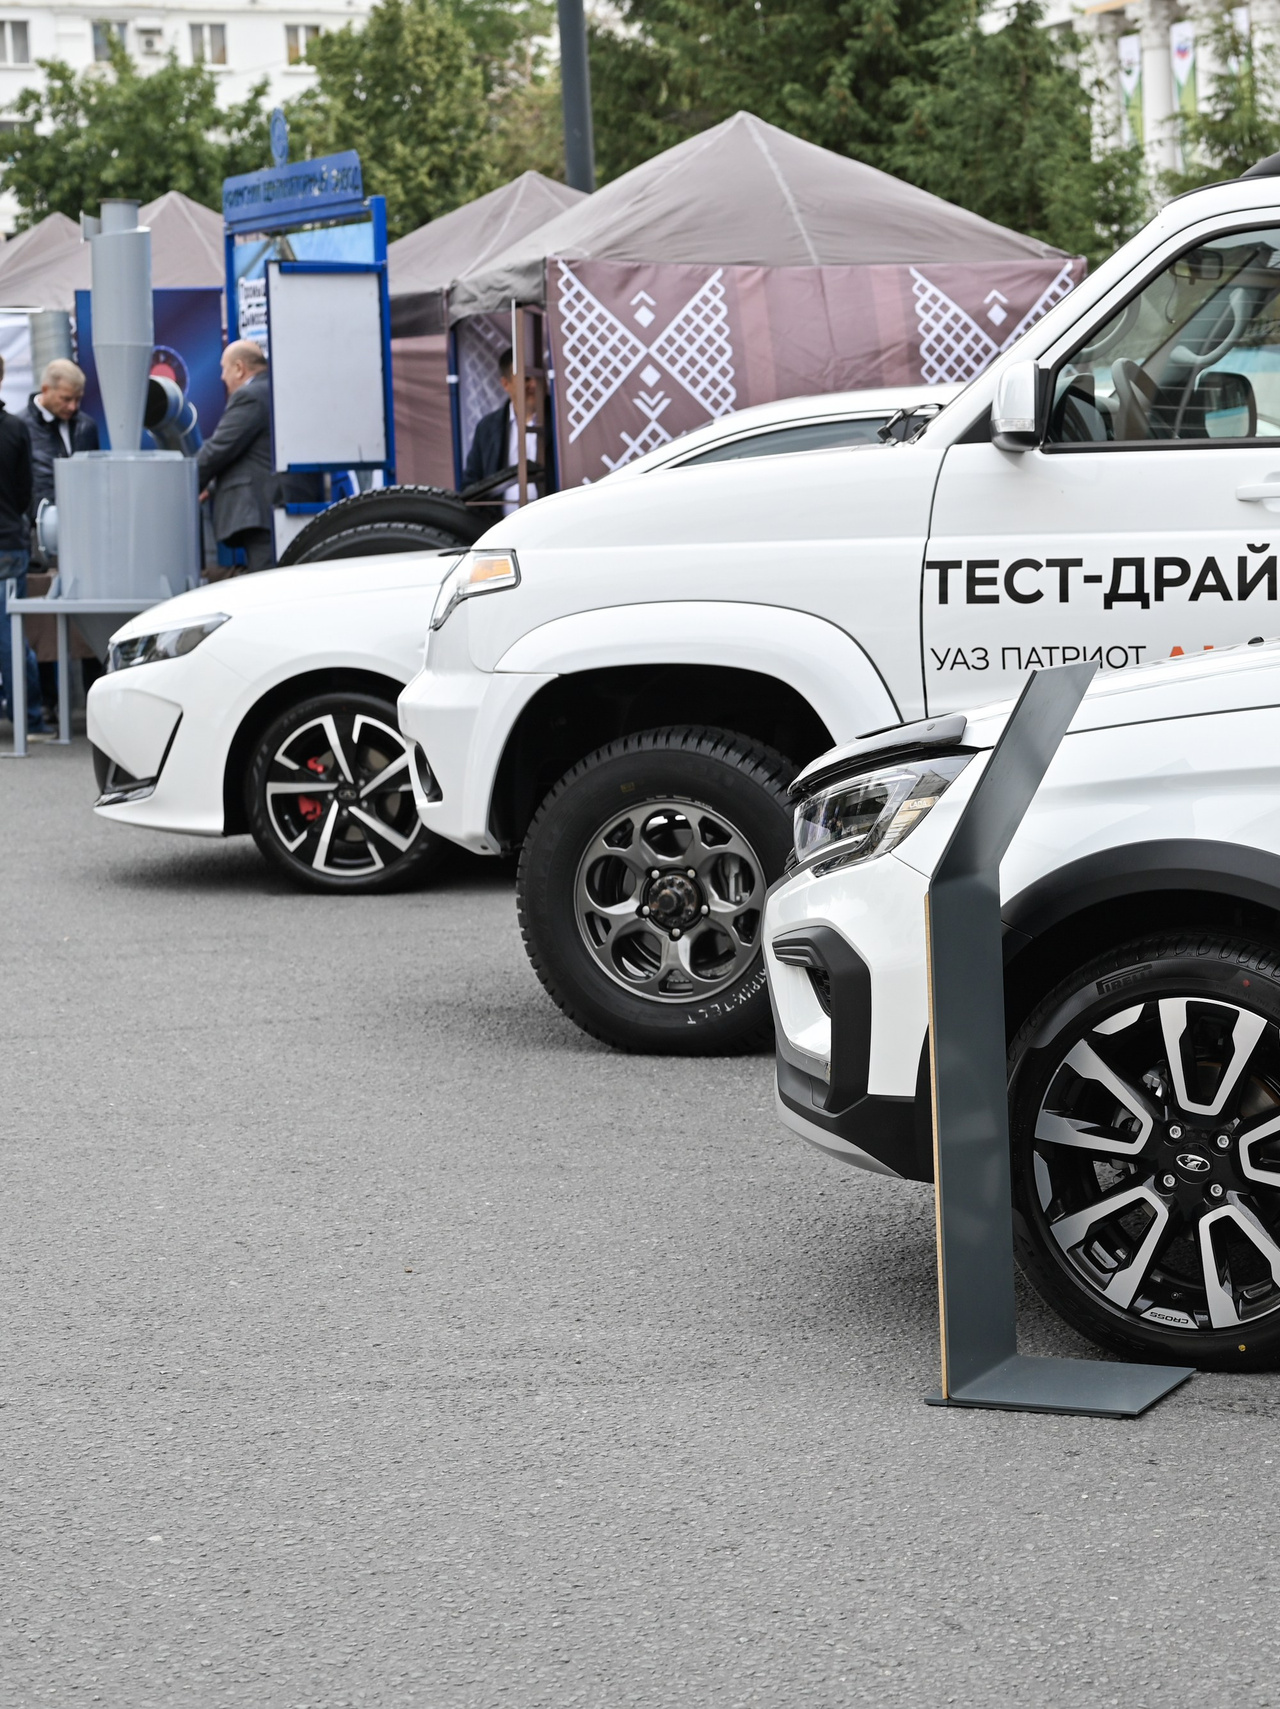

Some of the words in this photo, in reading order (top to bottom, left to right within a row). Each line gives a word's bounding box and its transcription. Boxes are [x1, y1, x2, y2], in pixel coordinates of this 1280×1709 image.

[930, 646, 990, 671] УАЗ
[1002, 645, 1147, 670] ПАТРИОТ
[1150, 1311, 1189, 1324] CROSS
